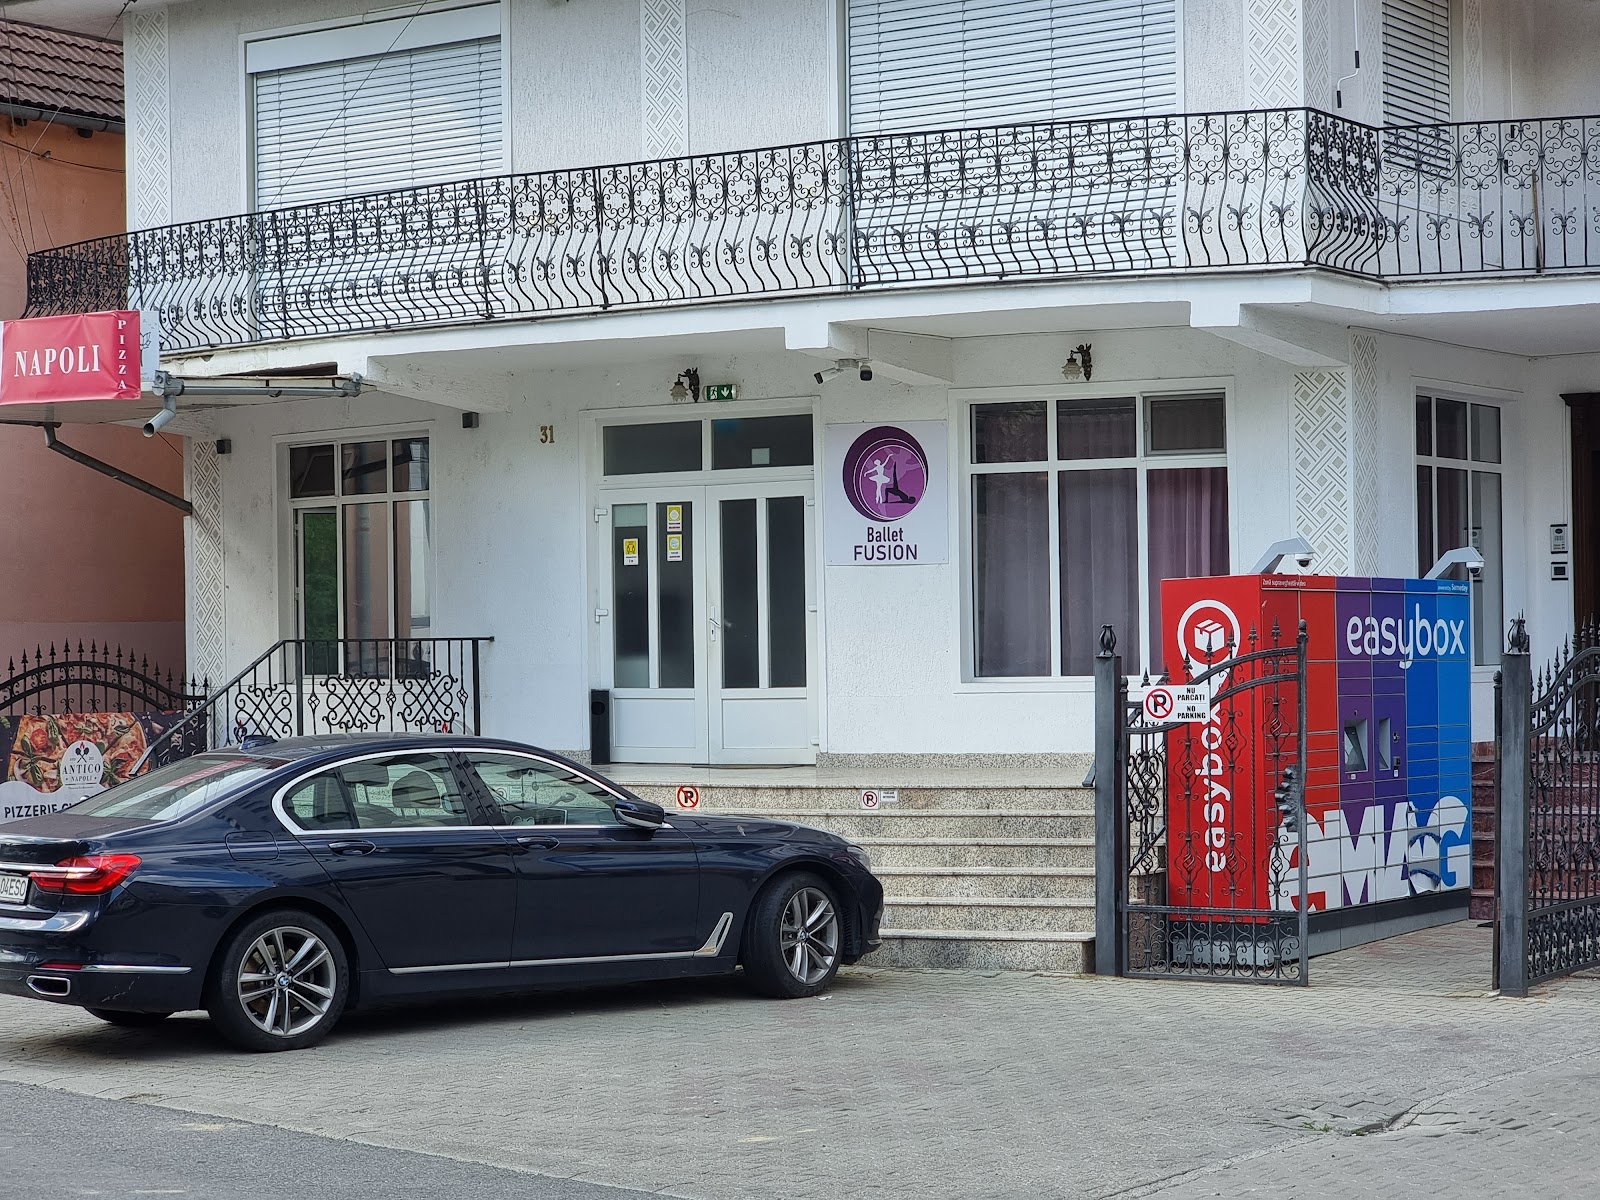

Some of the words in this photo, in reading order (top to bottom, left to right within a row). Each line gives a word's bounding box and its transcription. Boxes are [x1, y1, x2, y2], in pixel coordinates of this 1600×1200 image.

[14, 344, 100, 377] NAPOLI
[118, 319, 127, 390] PIZZA
[540, 425, 555, 444] 31
[867, 526, 903, 542] Ballet
[854, 544, 917, 561] FUSION
[1346, 603, 1466, 669] easybox
[62, 763, 101, 775] ANTICO
[4, 803, 57, 819] PIZZERIE
